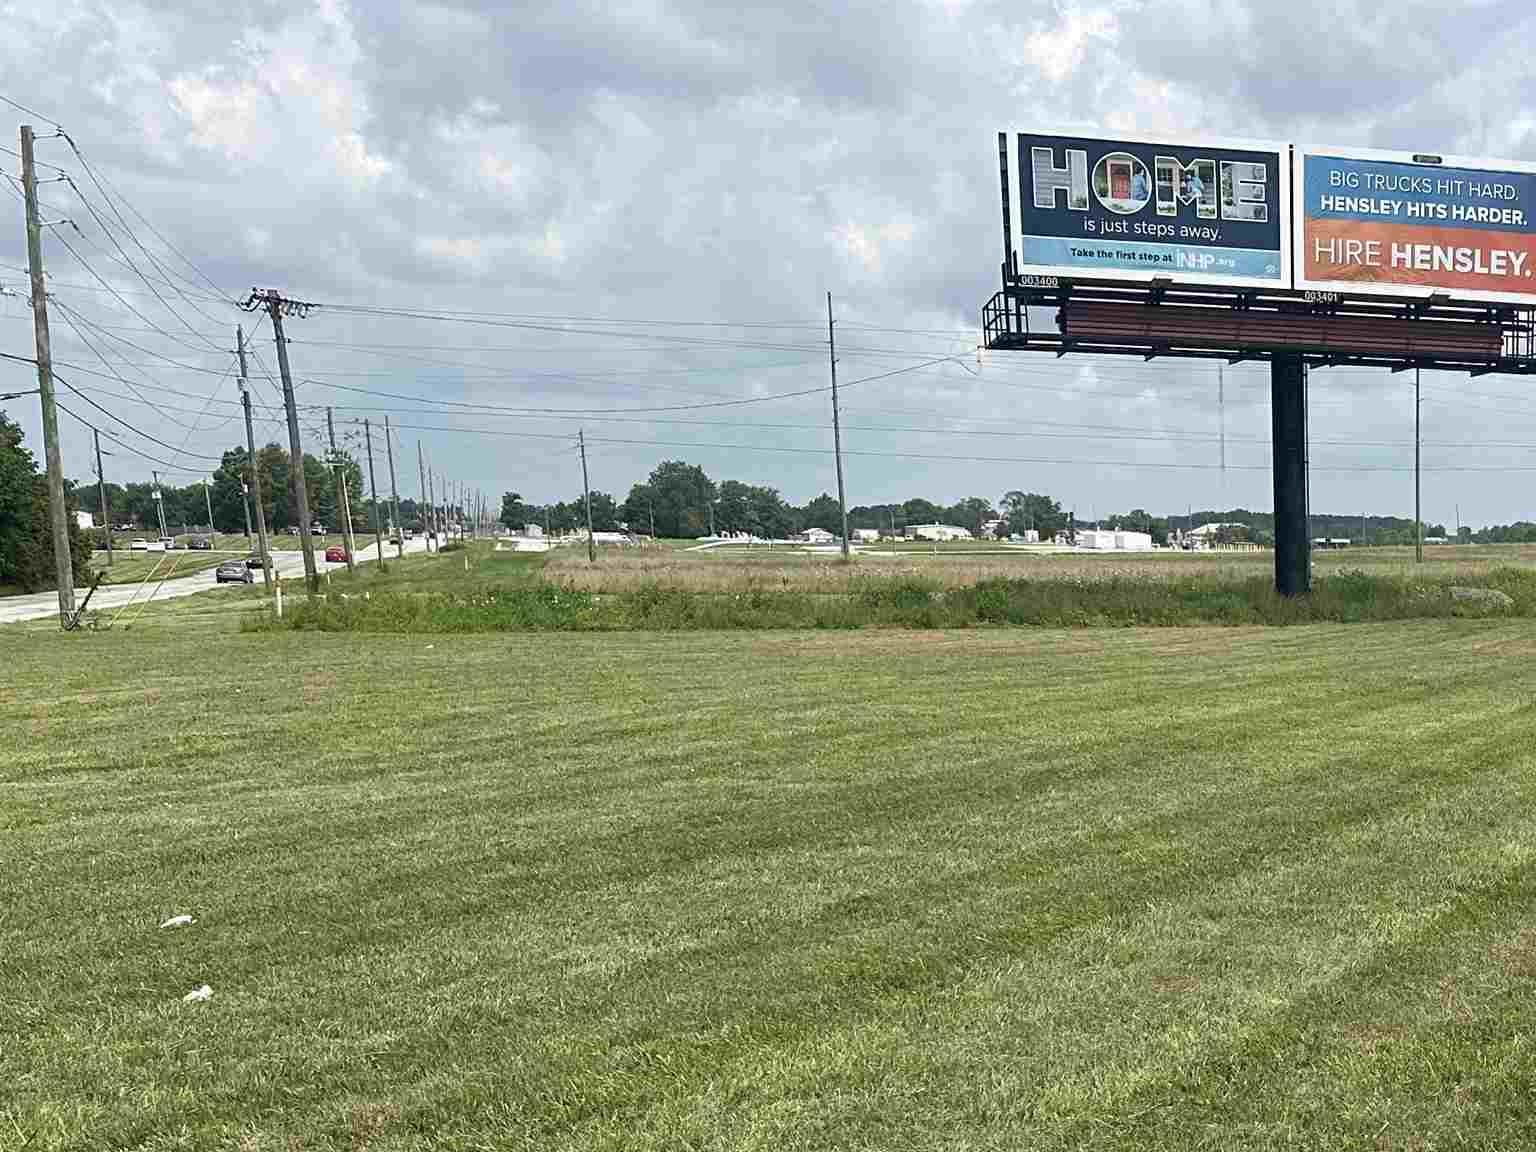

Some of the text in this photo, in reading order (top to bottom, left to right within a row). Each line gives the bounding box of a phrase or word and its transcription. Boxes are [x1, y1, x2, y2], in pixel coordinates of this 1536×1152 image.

[1031, 146, 1268, 223] HOME
[1329, 170, 1360, 188] BIG
[1366, 173, 1433, 194] TRUCKS
[1437, 179, 1465, 196] HIT
[1320, 195, 1528, 226] HENSLEY HITS HARDER.
[1084, 216, 1223, 241] is just steps away.
[1071, 247, 1095, 257] Take
[1097, 249, 1113, 258] the
[1115, 250, 1136, 260] first
[1138, 252, 1160, 263] step
[1162, 254, 1172, 262] at
[1314, 237, 1533, 277] HIRE HENSLEY.
